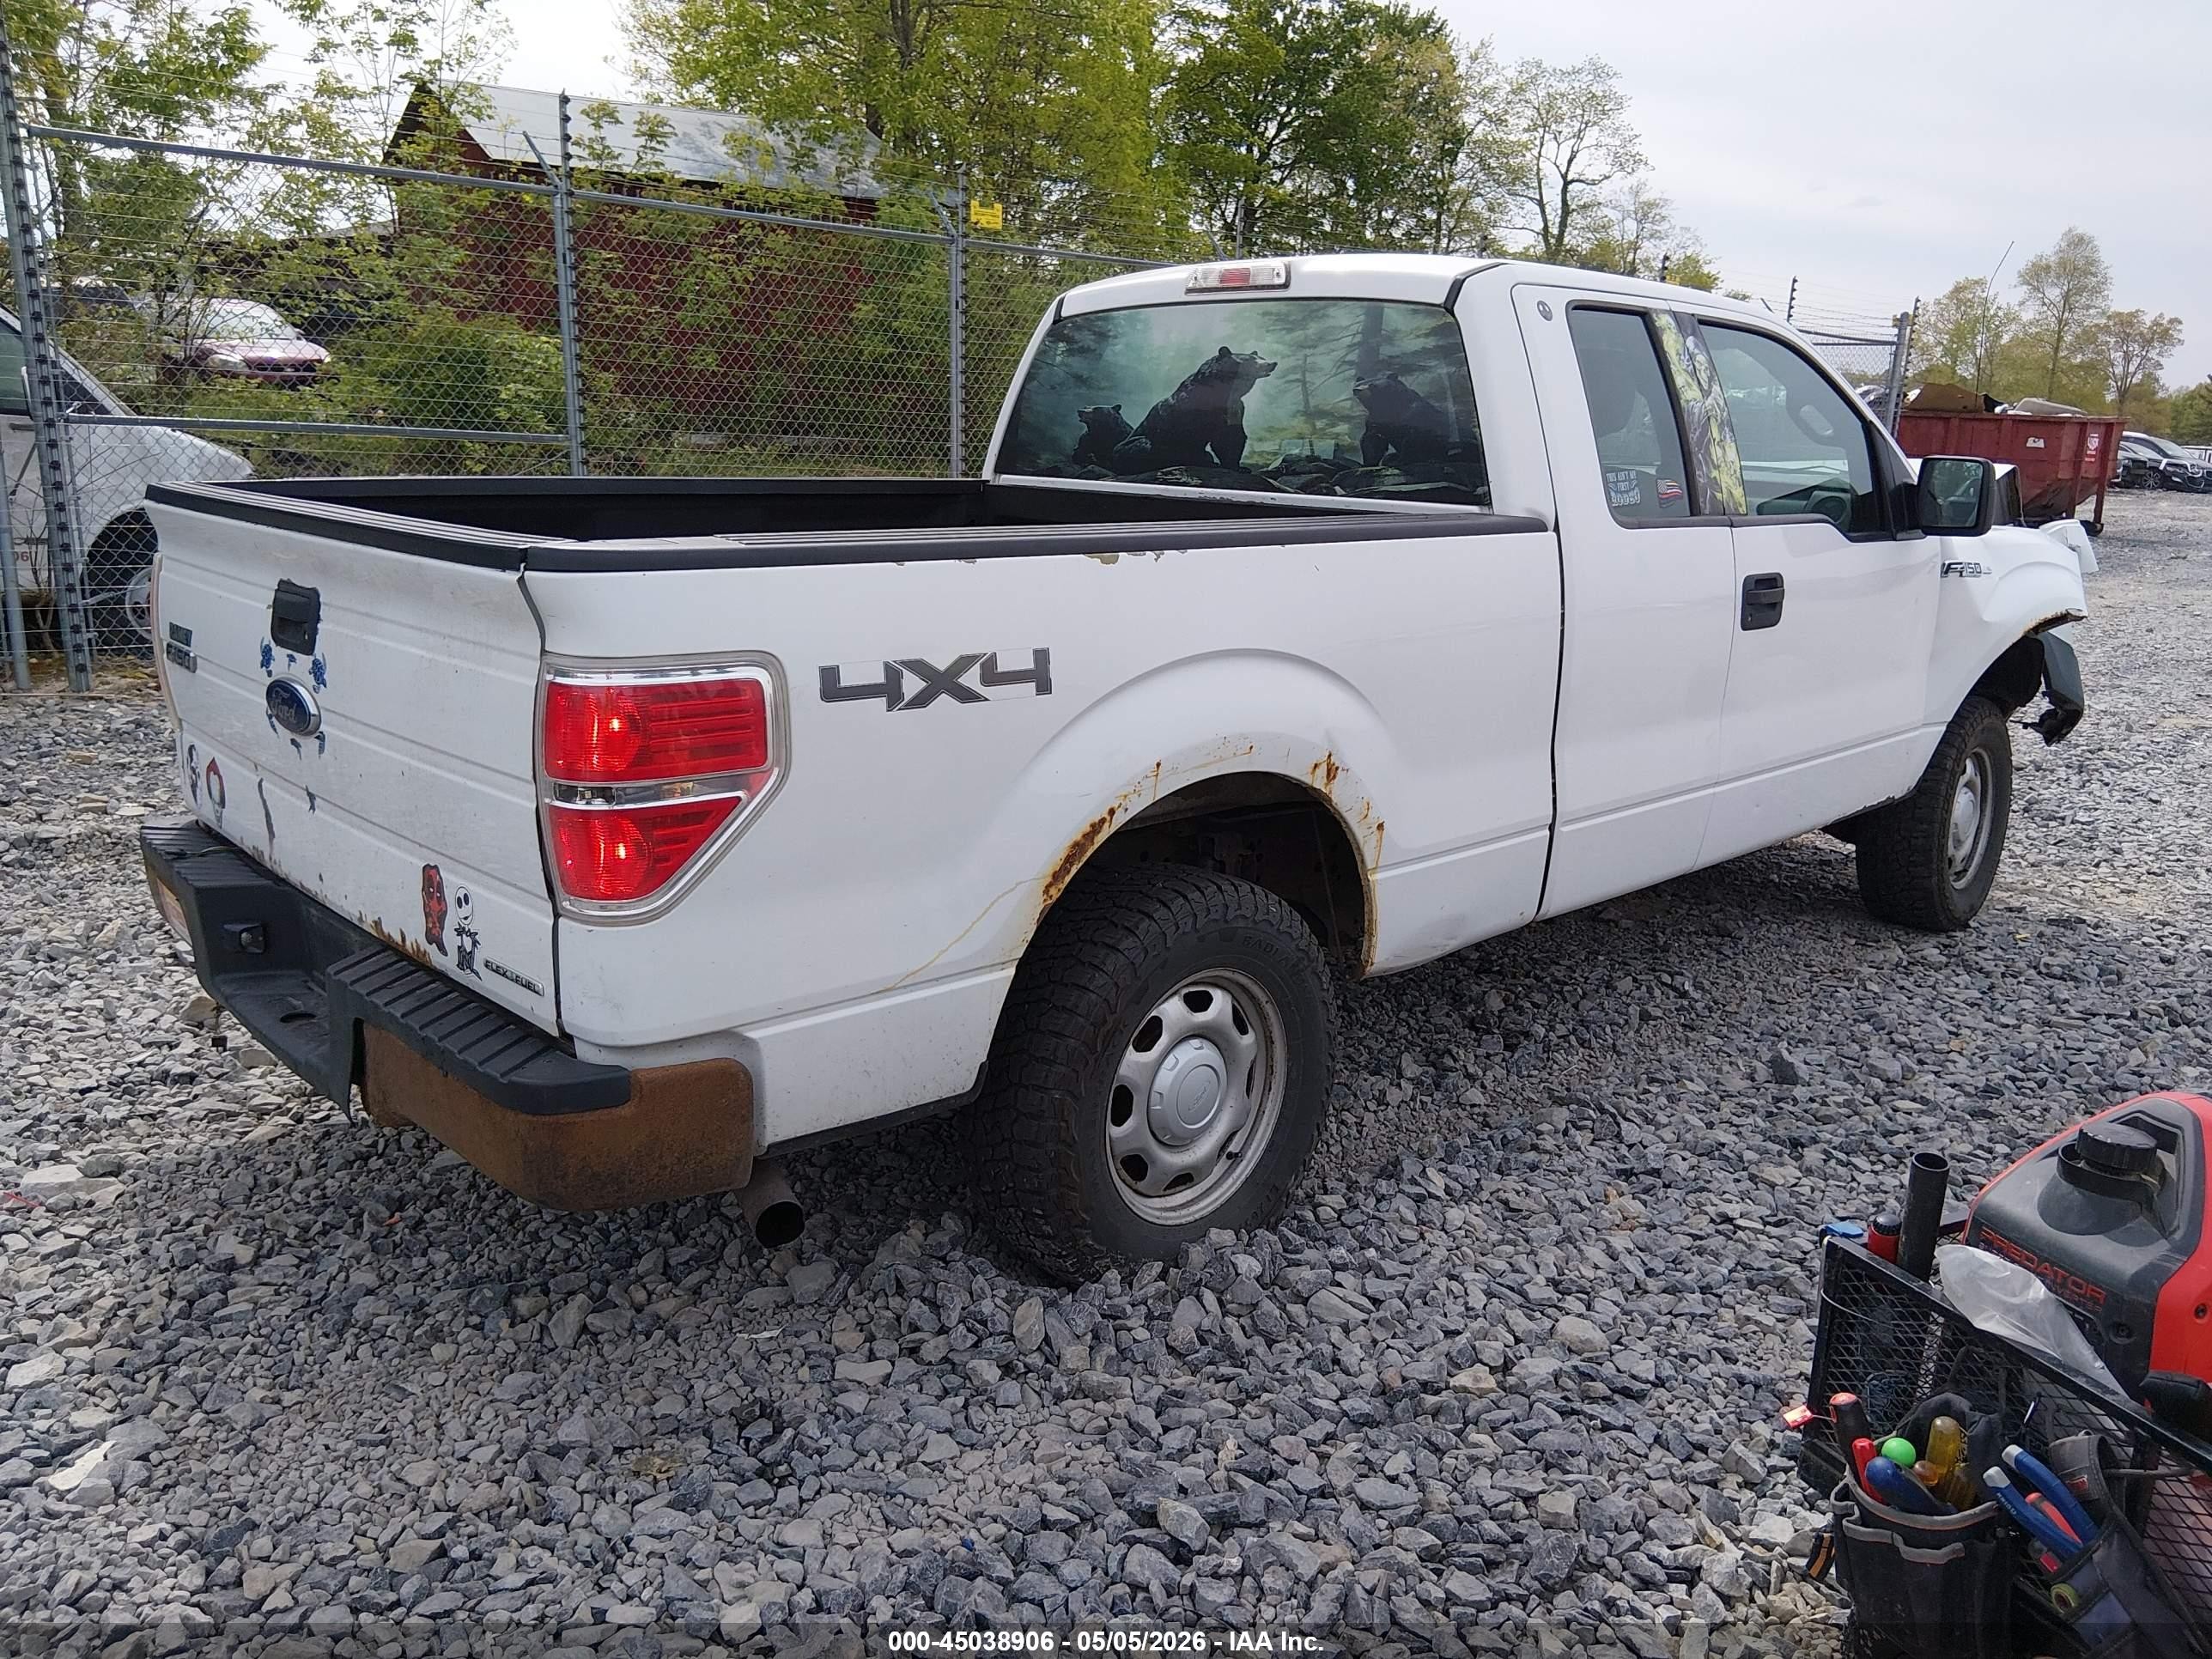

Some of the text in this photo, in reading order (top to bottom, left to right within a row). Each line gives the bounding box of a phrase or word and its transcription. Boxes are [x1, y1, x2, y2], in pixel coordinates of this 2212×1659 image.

[1606, 472, 1617, 483] THIS
[1617, 482, 1629, 491] FIRST
[269, 686, 297, 723] Ford
[485, 959, 538, 993] FLEX FUEL
[1978, 1226, 2107, 1305] PREDATOR
